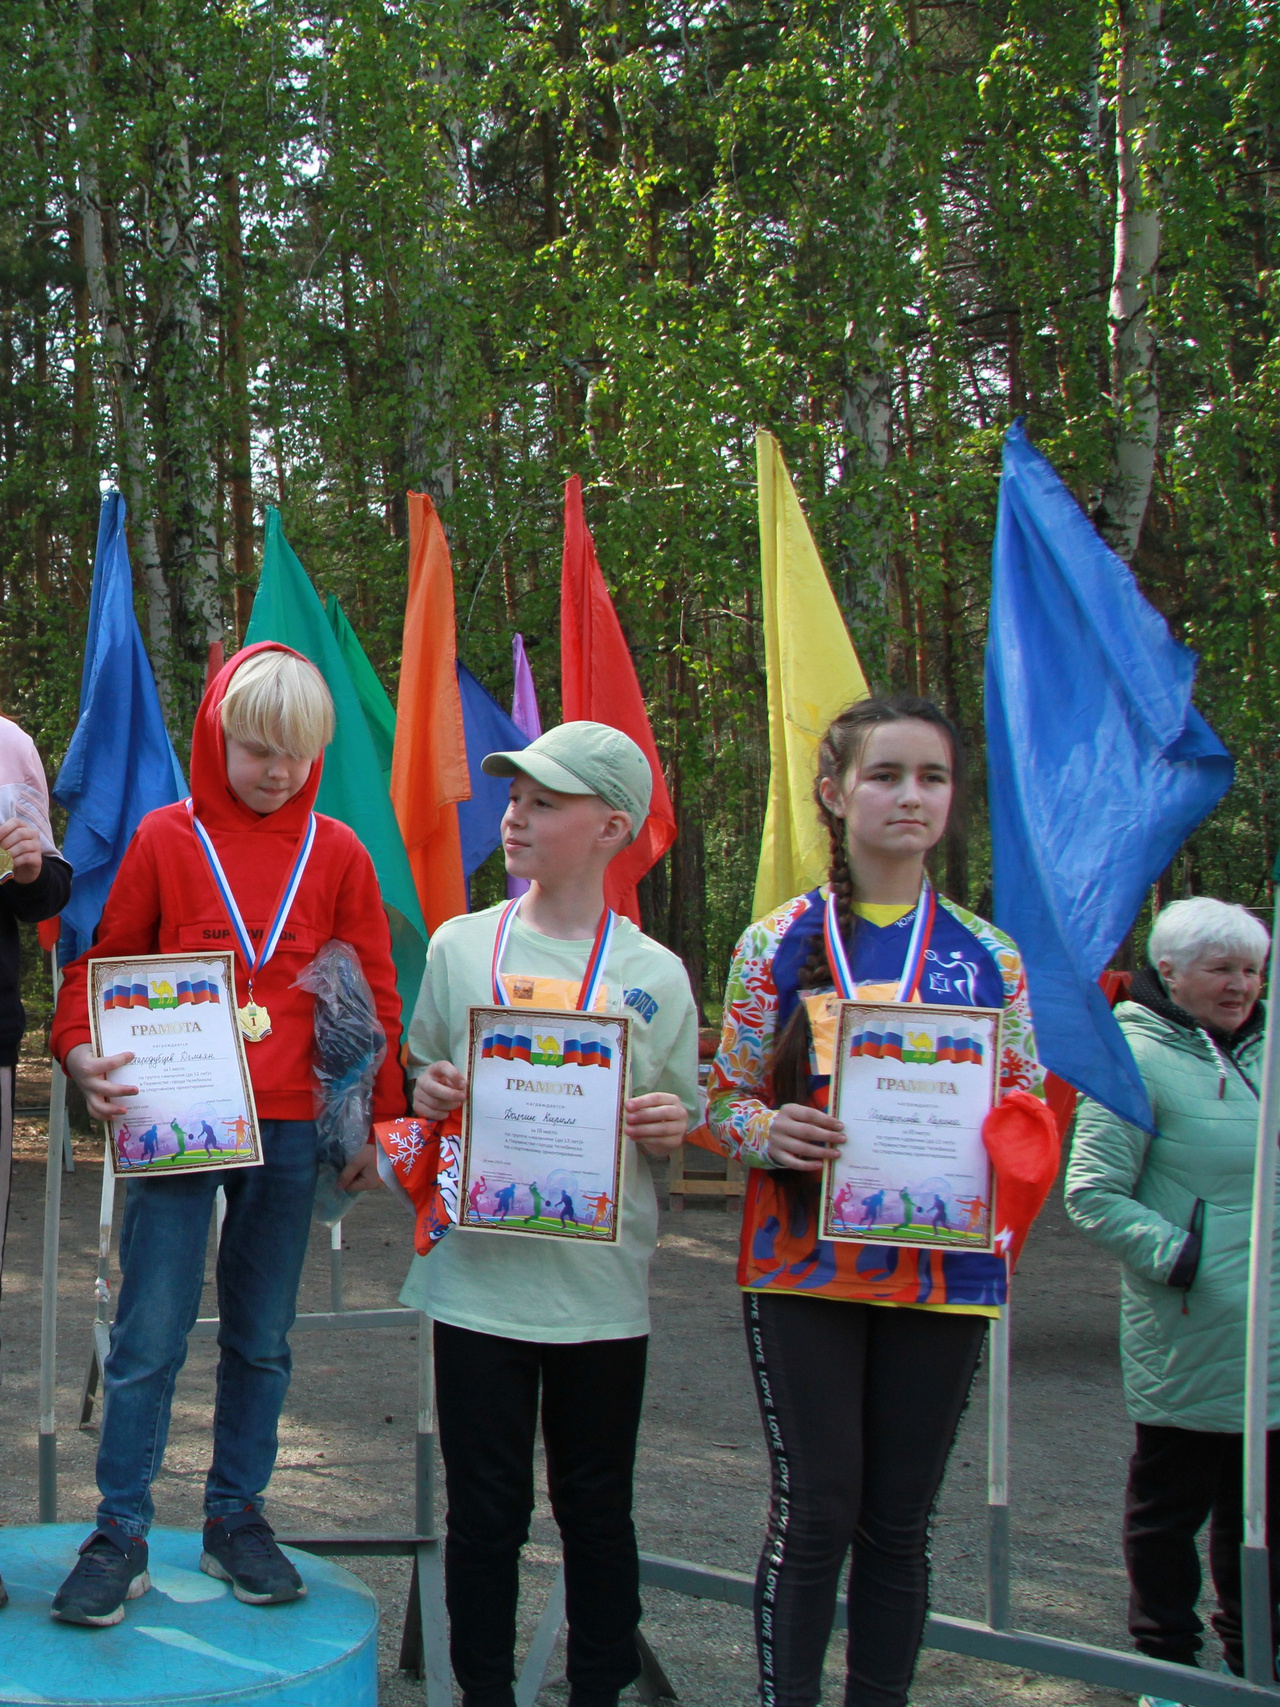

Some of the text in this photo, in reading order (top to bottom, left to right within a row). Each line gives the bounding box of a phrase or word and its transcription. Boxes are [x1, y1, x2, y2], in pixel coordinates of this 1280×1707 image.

[202, 929, 297, 942] SUPVION
[130, 1021, 202, 1037] ГРАМОТА
[251, 1016, 256, 1027] 1
[506, 1078, 584, 1097] ГРАМОТА
[876, 1077, 958, 1095] ГРАМОТА
[525, 1101, 565, 1109] награждается
[753, 1327, 765, 1363] LOVE
[759, 1370, 774, 1408] LOVE
[767, 1414, 784, 1451] LOVE
[778, 1456, 790, 1493] LOVE
[763, 1567, 779, 1603] LOVE
[762, 1605, 773, 1640] LOVE
[762, 1642, 774, 1678] LOVE
